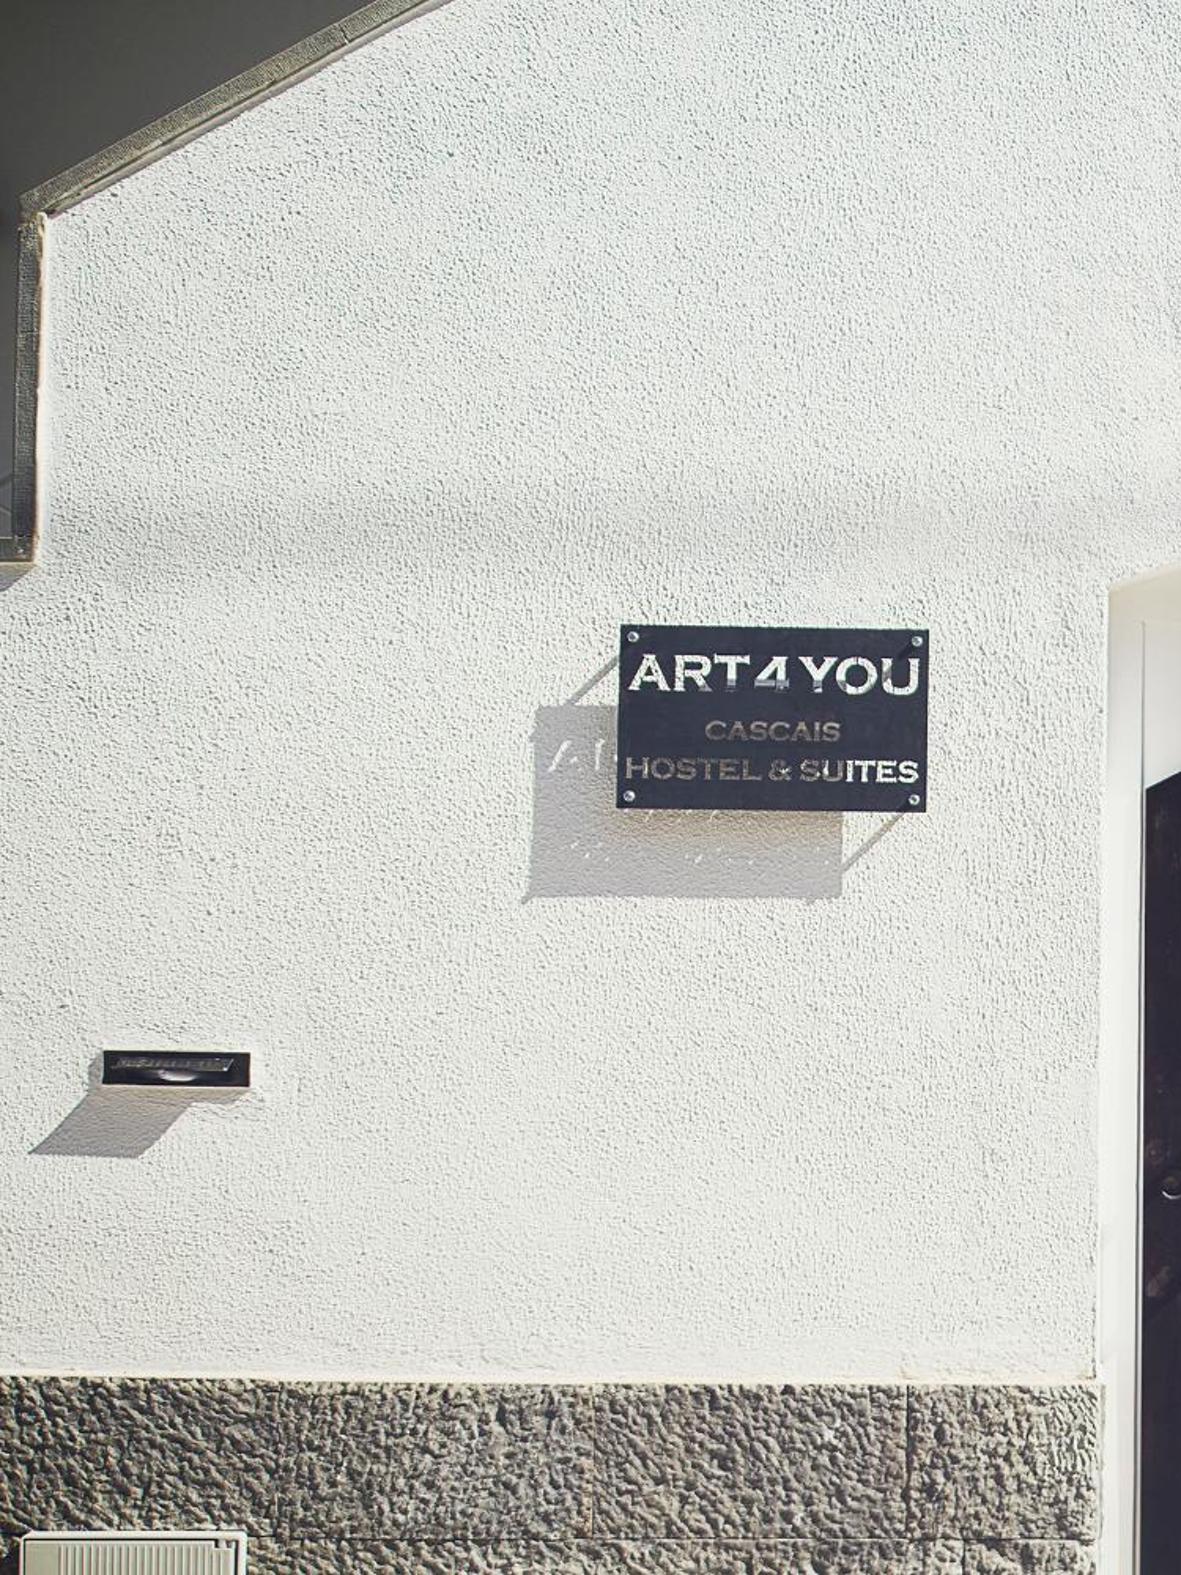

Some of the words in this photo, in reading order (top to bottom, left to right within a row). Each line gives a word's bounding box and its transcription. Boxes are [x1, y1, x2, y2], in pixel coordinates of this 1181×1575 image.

[704, 720, 841, 742] CASCAIS
[624, 756, 762, 781] HOSTEL
[768, 758, 792, 782] &
[800, 759, 920, 784] SUITES
